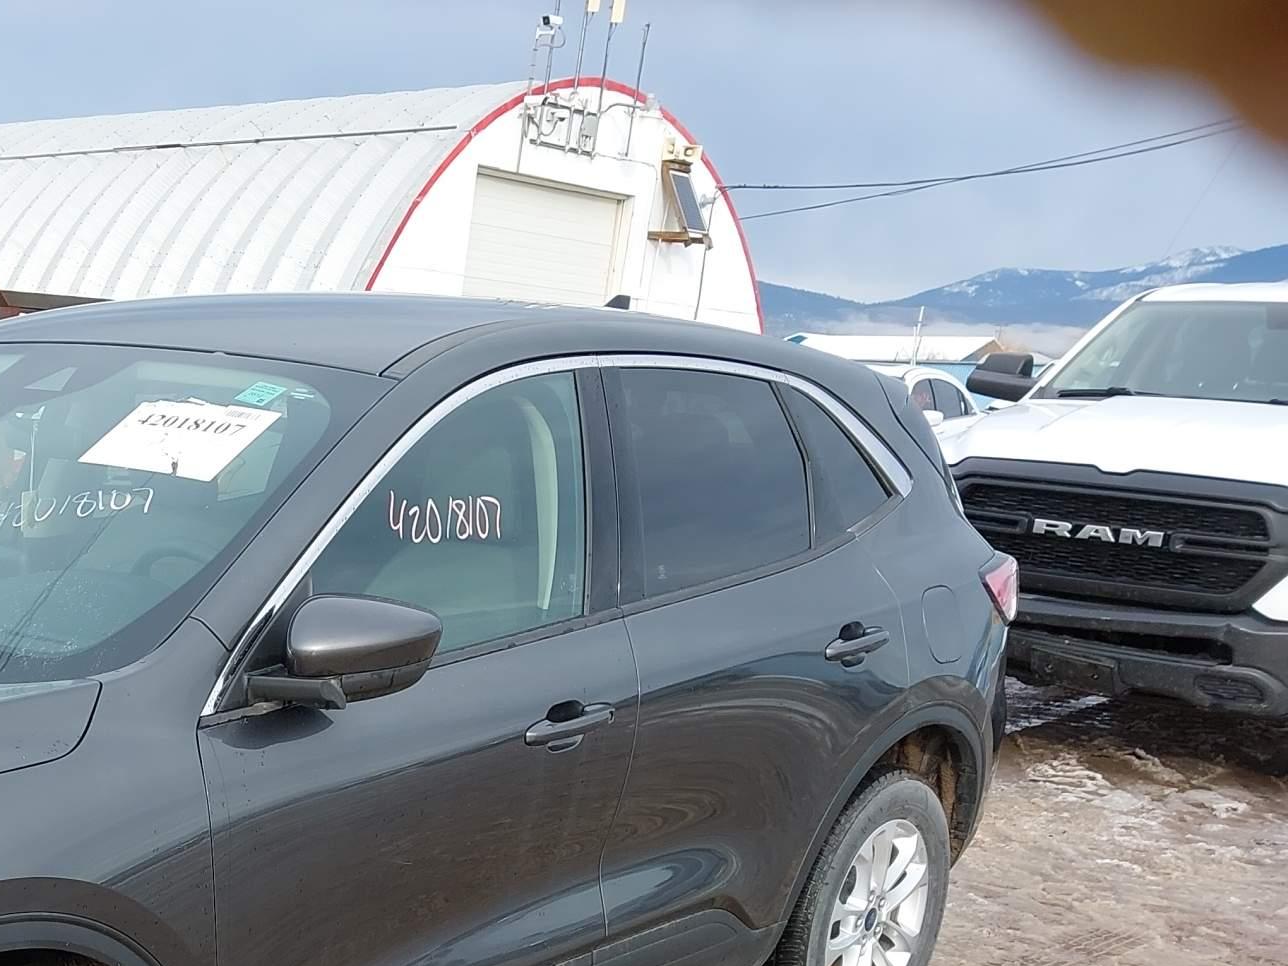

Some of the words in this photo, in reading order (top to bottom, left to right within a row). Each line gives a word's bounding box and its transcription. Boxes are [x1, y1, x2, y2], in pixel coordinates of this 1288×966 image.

[138, 413, 247, 436] 42018107
[389, 489, 501, 544] 42018107
[1032, 518, 1165, 548] RAM
